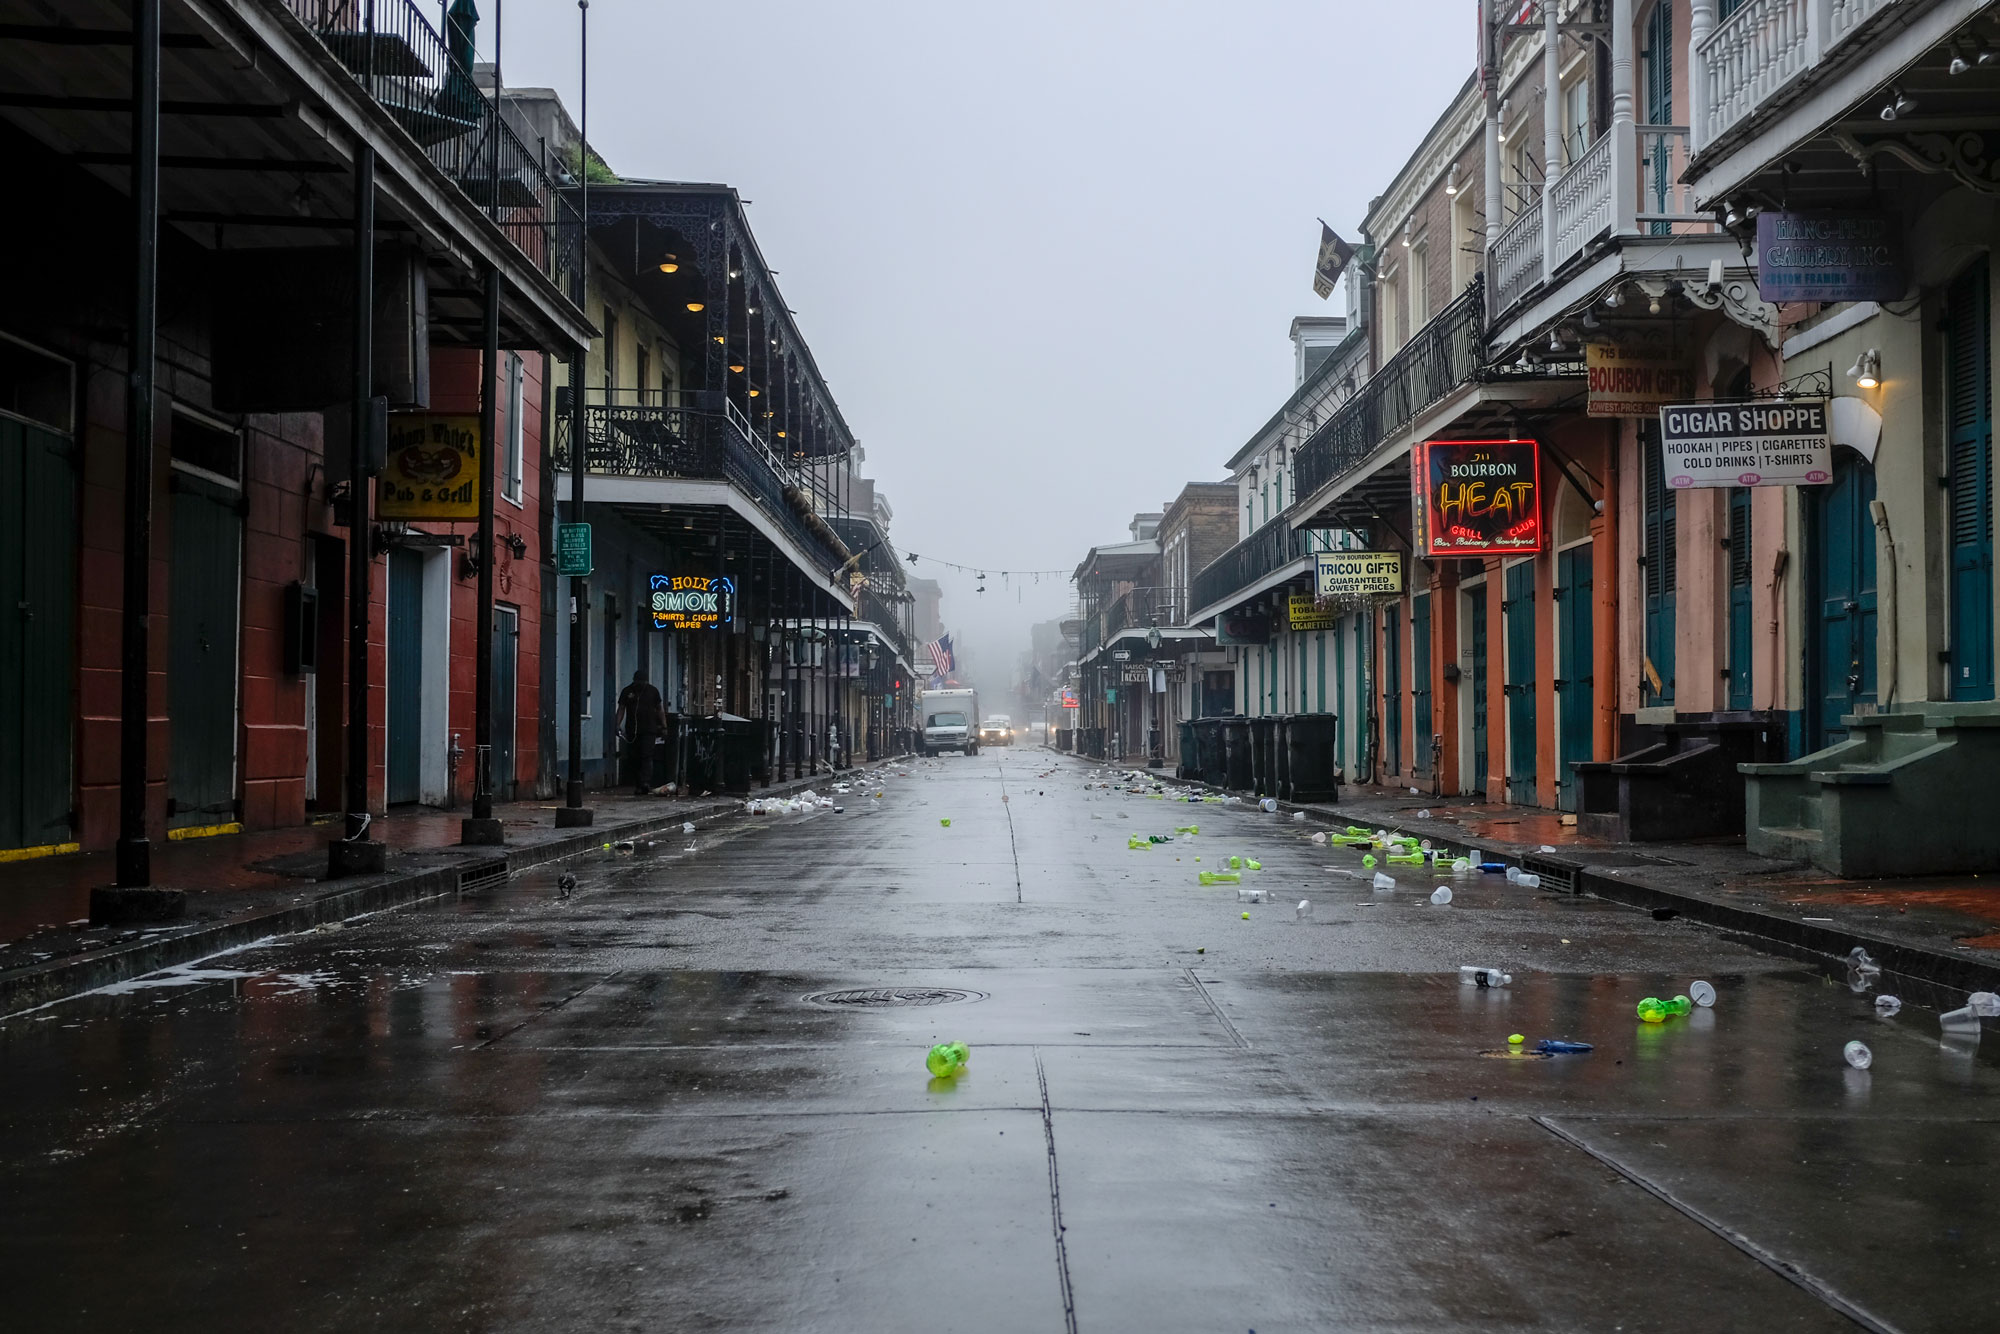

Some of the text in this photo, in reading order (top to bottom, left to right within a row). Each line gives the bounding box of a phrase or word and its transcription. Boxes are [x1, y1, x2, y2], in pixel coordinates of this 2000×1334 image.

[1600, 348, 1615, 359] 715
[1590, 367, 1696, 397] BOURBON GIFTS
[1621, 401, 1643, 413] PRICE
[1668, 408, 1822, 434] CIGAR SHOPPE
[1668, 438, 1826, 455] HOOKAH PIPES CIGARETTES
[1683, 454, 1814, 469] COLD DRINKS T-SHIRTS
[1450, 463, 1518, 477] BOURBON
[1675, 477, 1690, 486] ATM
[1742, 475, 1758, 484] ATM
[1809, 472, 1825, 481] ATM
[384, 479, 473, 503] Pub & Grill
[1440, 481, 1534, 528] HEAT
[1451, 526, 1483, 540] GRILL
[1509, 519, 1536, 537] CLUB
[1433, 536, 1535, 548] Bar Balcony Courtyard
[1320, 562, 1399, 575] TRICOU GIFTS
[671, 576, 711, 591] HOLY
[1330, 577, 1389, 585] GUARANTEED
[1324, 583, 1395, 592] LOWEST PRICES
[652, 592, 731, 613] SMOK
[1292, 606, 1332, 614] TOBA
[652, 612, 685, 622] T-SHIRTS
[675, 622, 702, 630] VAPES
[1291, 621, 1334, 631] CIGARETTES
